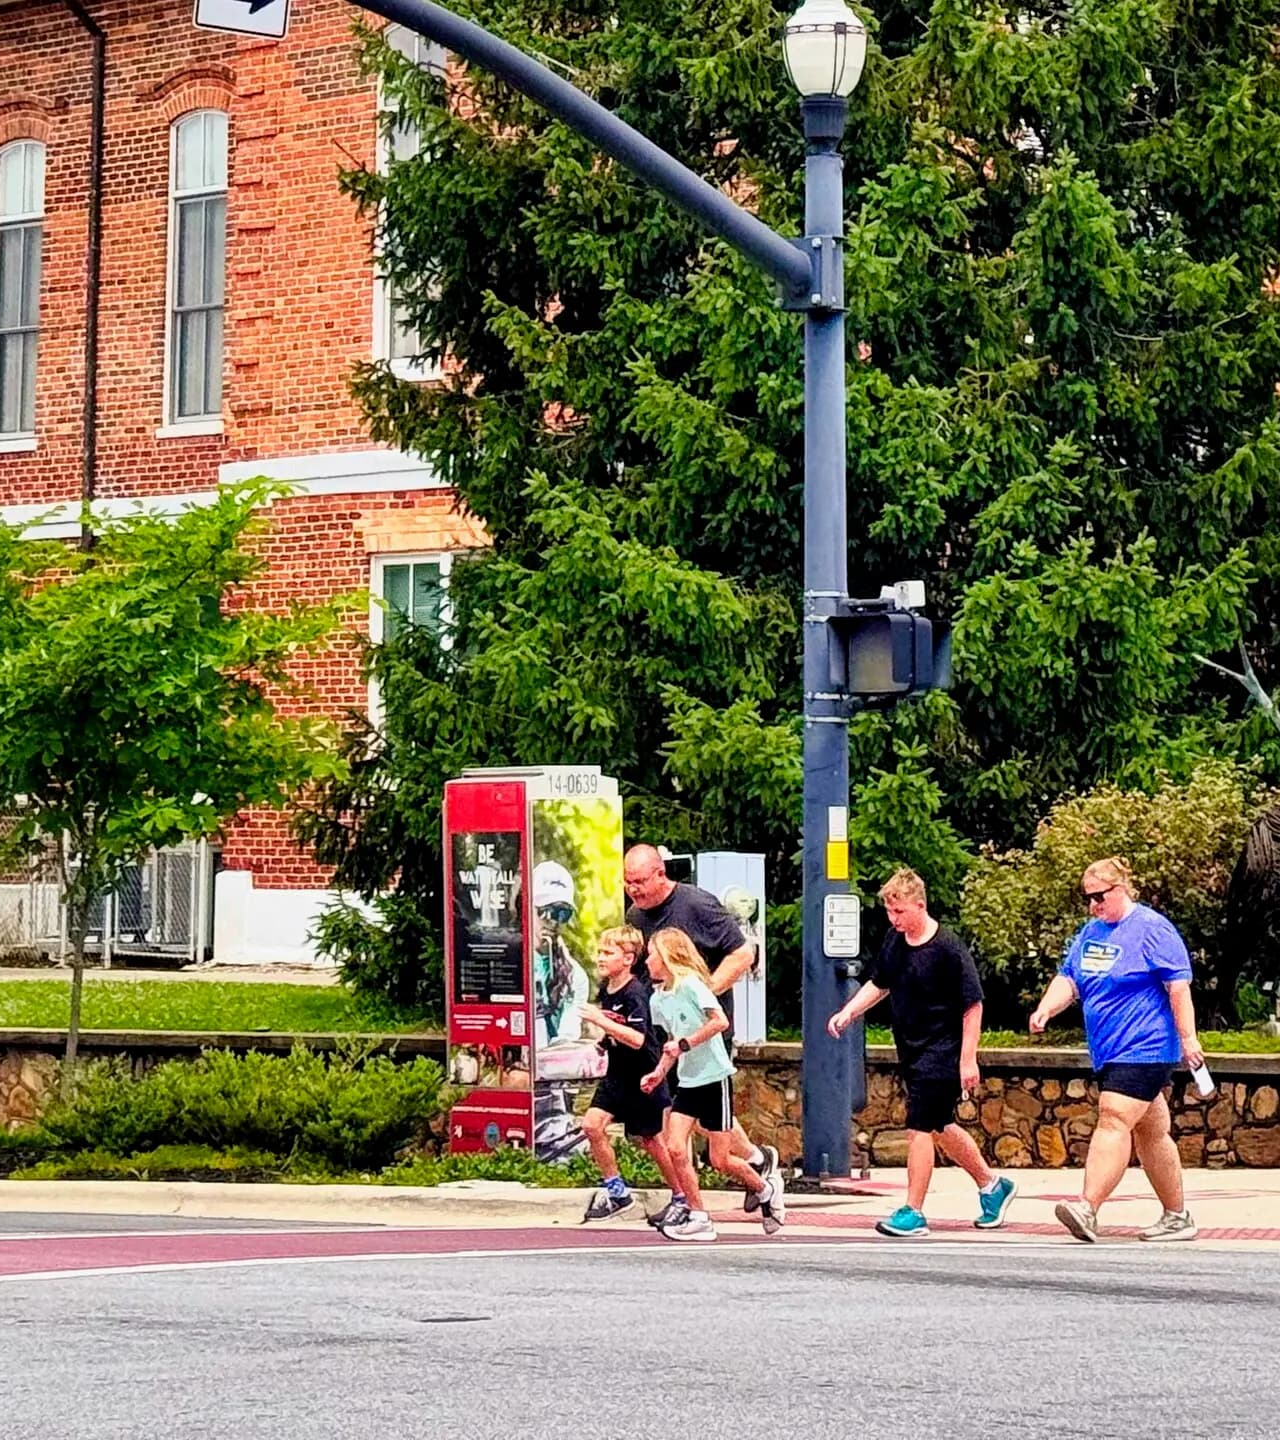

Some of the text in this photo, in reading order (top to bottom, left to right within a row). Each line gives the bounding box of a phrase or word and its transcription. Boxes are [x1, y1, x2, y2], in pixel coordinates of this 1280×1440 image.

[548, 773, 599, 795] 14-0639
[478, 843, 496, 864] BE
[469, 889, 506, 910] WSE
